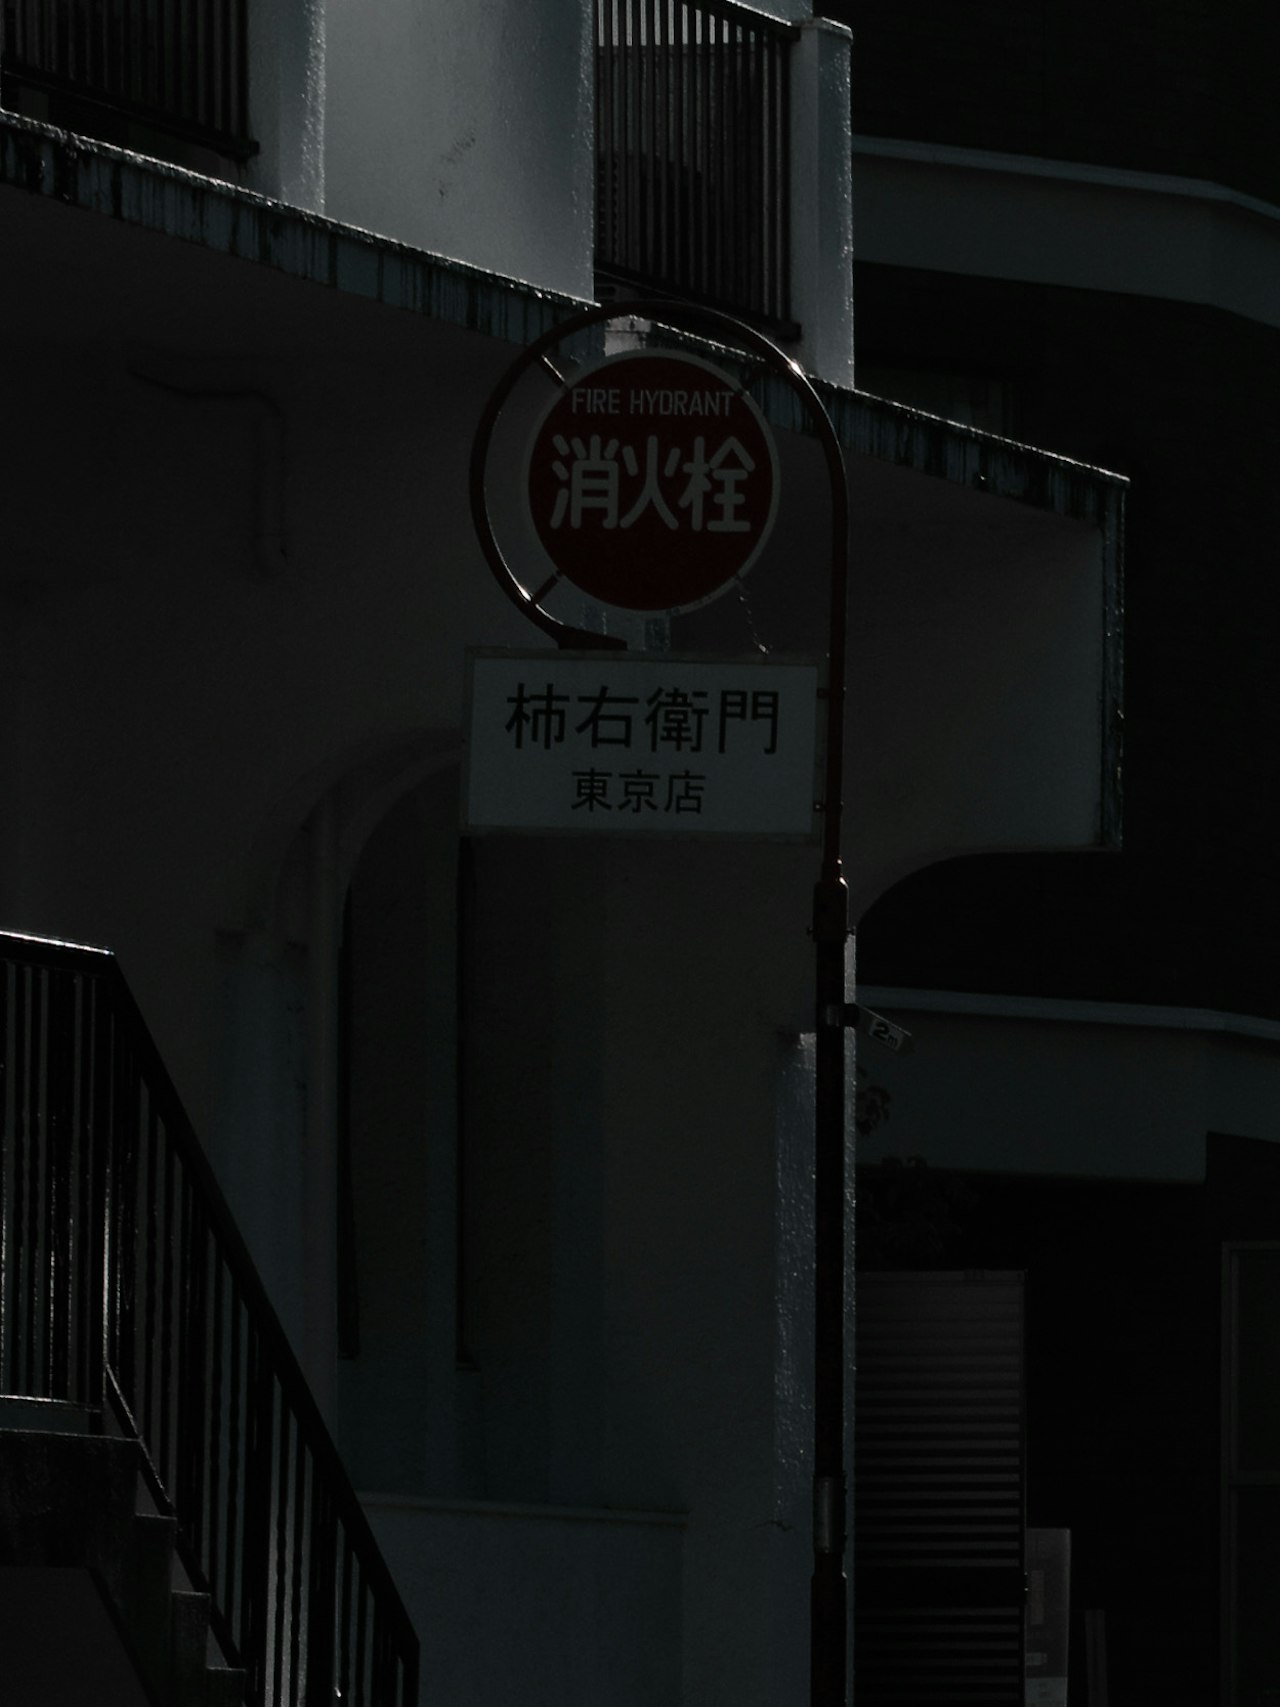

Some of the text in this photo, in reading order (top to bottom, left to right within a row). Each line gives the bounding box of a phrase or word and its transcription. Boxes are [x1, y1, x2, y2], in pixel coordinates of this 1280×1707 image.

[571, 387, 735, 417] FIRE HYDRANT
[550, 434, 757, 533] 消火栓
[505, 683, 779, 754] 柿右衛門
[571, 768, 706, 814] 東京店
